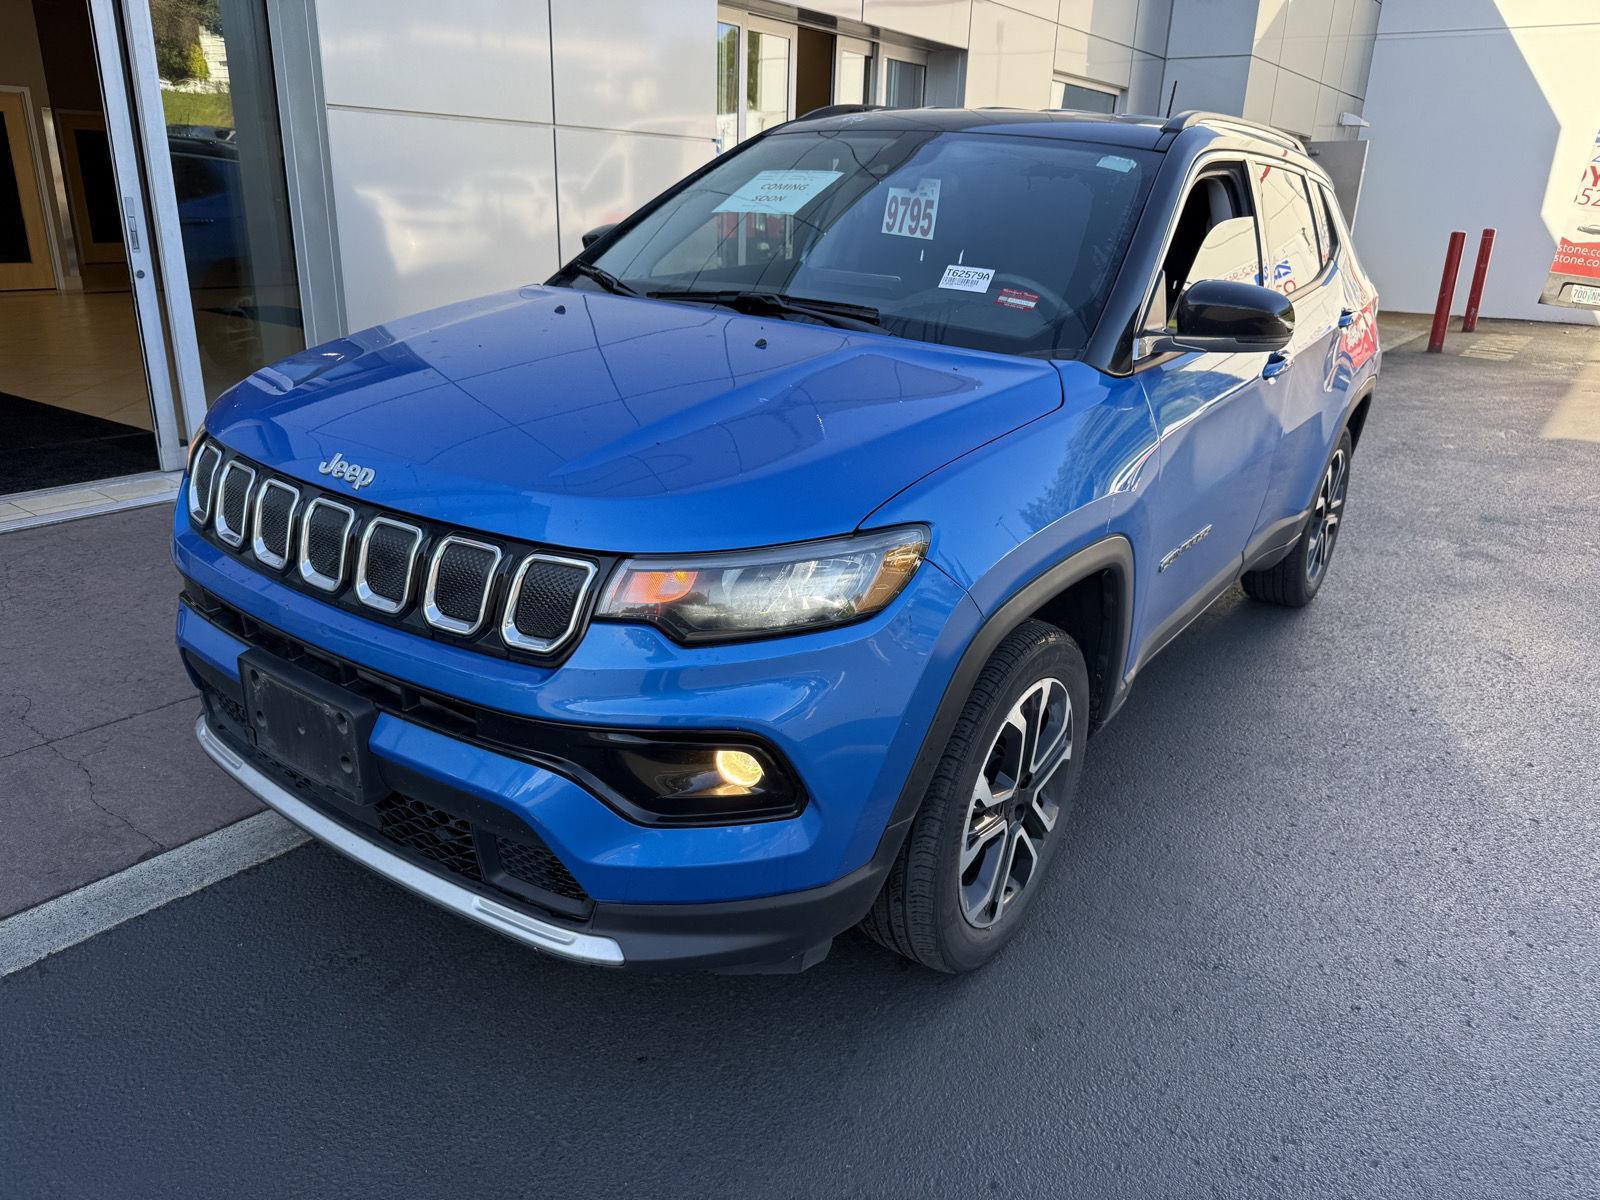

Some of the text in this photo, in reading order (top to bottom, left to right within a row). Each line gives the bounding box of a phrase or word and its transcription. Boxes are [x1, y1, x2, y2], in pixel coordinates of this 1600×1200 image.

[885, 195, 935, 237] 9795
[946, 268, 990, 281] T62579A
[318, 452, 376, 490] Jeep
